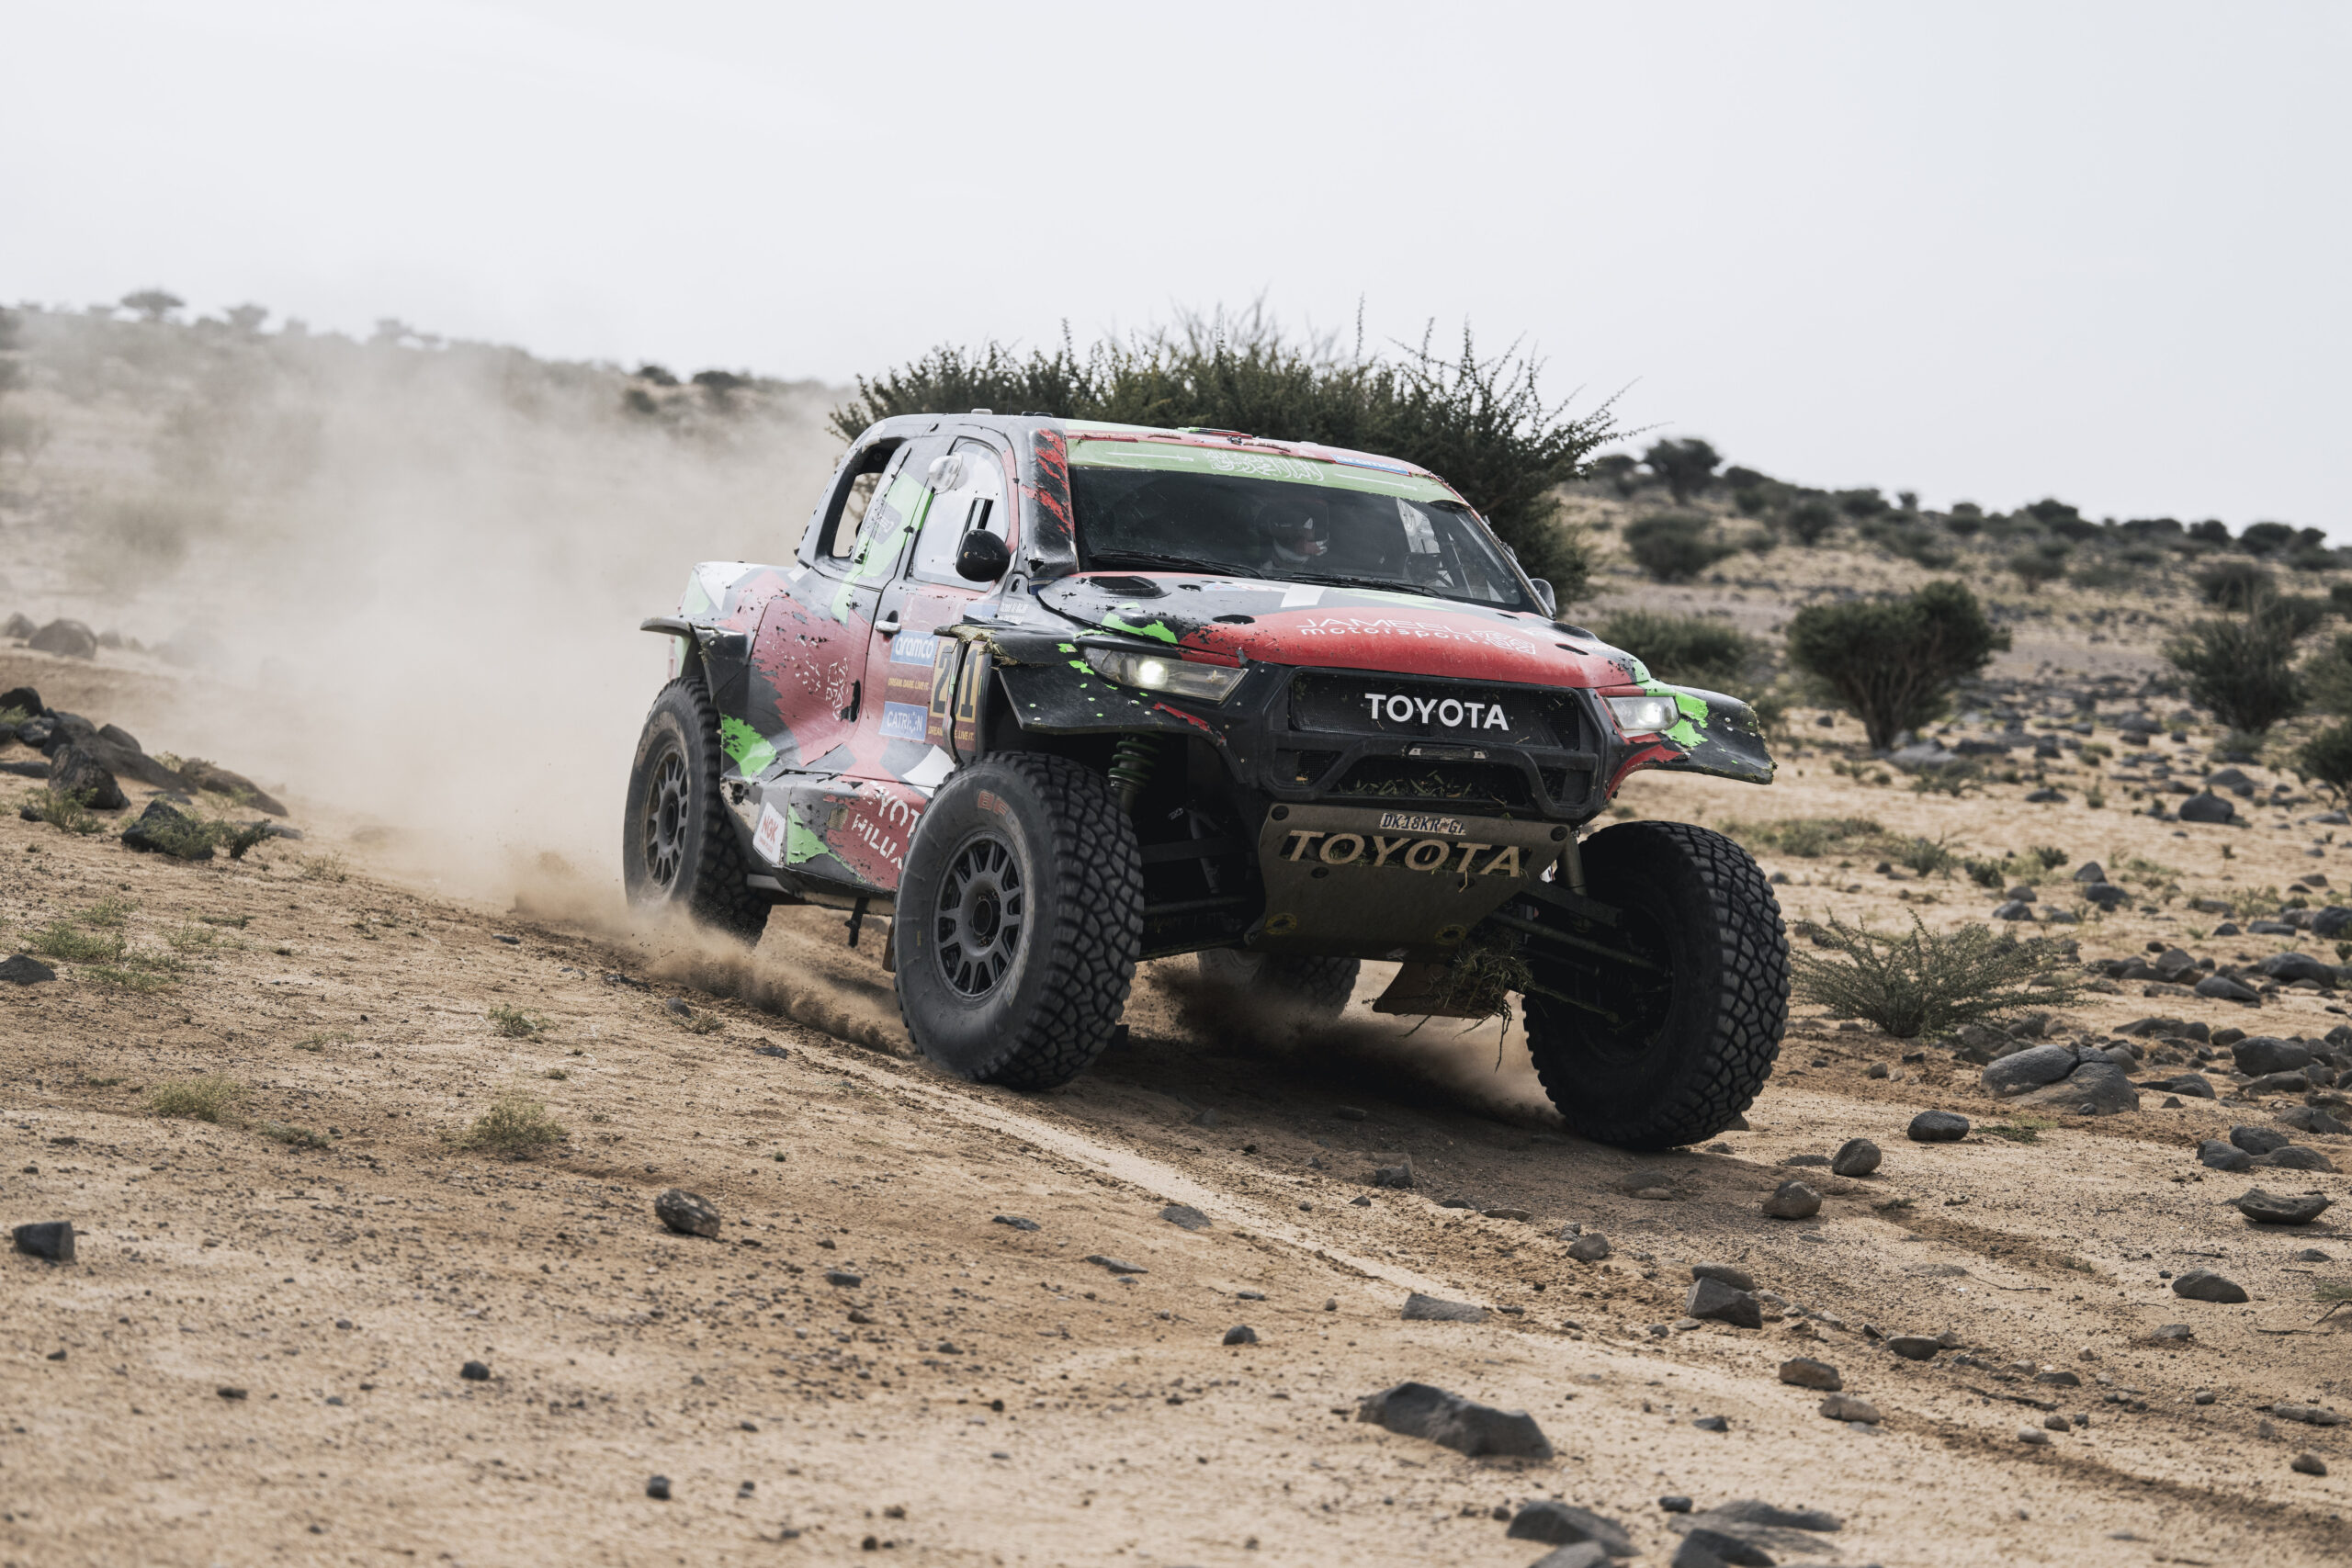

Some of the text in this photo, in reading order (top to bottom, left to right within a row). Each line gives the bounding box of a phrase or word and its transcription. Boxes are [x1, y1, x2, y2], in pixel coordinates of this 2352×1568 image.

[1296, 618, 1471, 636] JAMEEL
[1301, 627, 1477, 643] motorsport
[895, 637, 933, 659] aramco
[933, 645, 978, 719] 21
[1364, 693, 1510, 731] TOYOTA
[761, 815, 779, 844] NGK
[1288, 829, 1521, 878] TOYOTA
